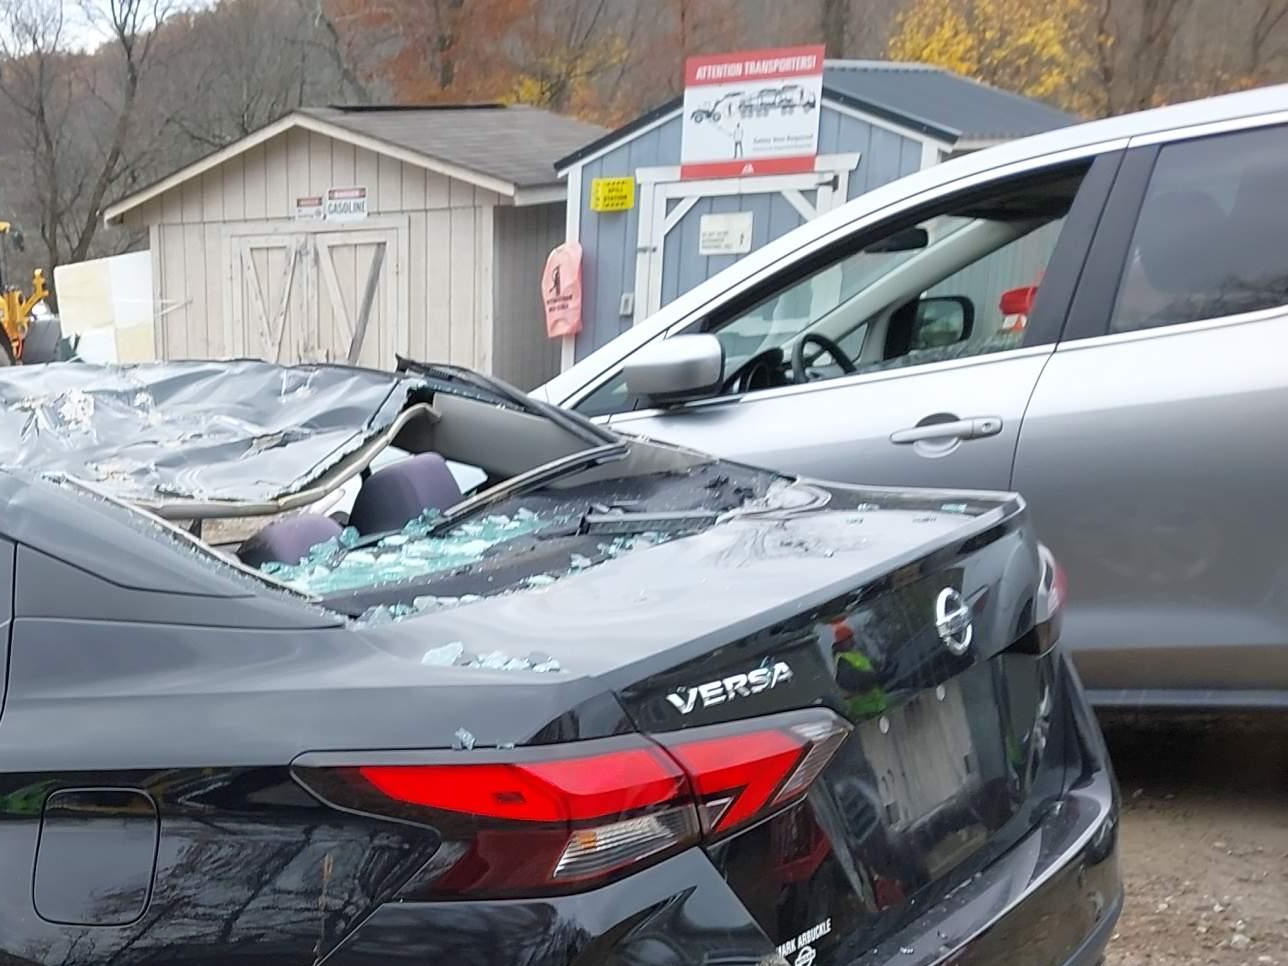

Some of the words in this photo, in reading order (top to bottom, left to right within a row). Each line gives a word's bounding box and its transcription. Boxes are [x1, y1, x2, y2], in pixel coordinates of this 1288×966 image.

[696, 62, 743, 80] ATTENTION
[744, 55, 817, 75] TRANSPORTERS!
[328, 200, 364, 214] GASOLINE
[665, 662, 793, 714] VERSA
[797, 918, 831, 949] ARBUCKLE
